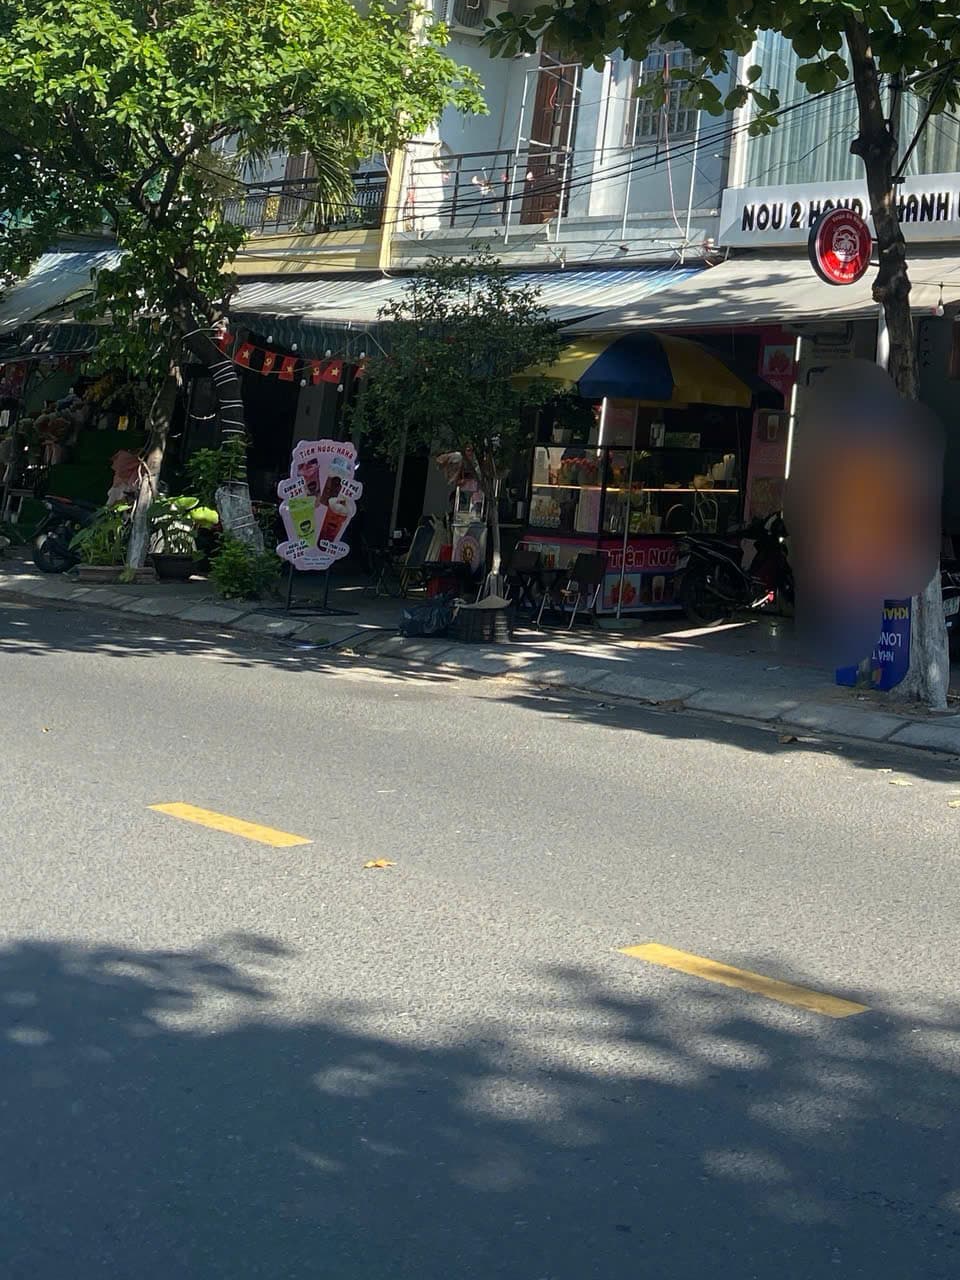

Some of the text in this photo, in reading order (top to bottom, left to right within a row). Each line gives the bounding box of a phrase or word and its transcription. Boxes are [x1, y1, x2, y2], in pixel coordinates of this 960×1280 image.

[741, 203, 782, 231] NOU
[789, 201, 802, 229] 2
[878, 631, 902, 648] LON
